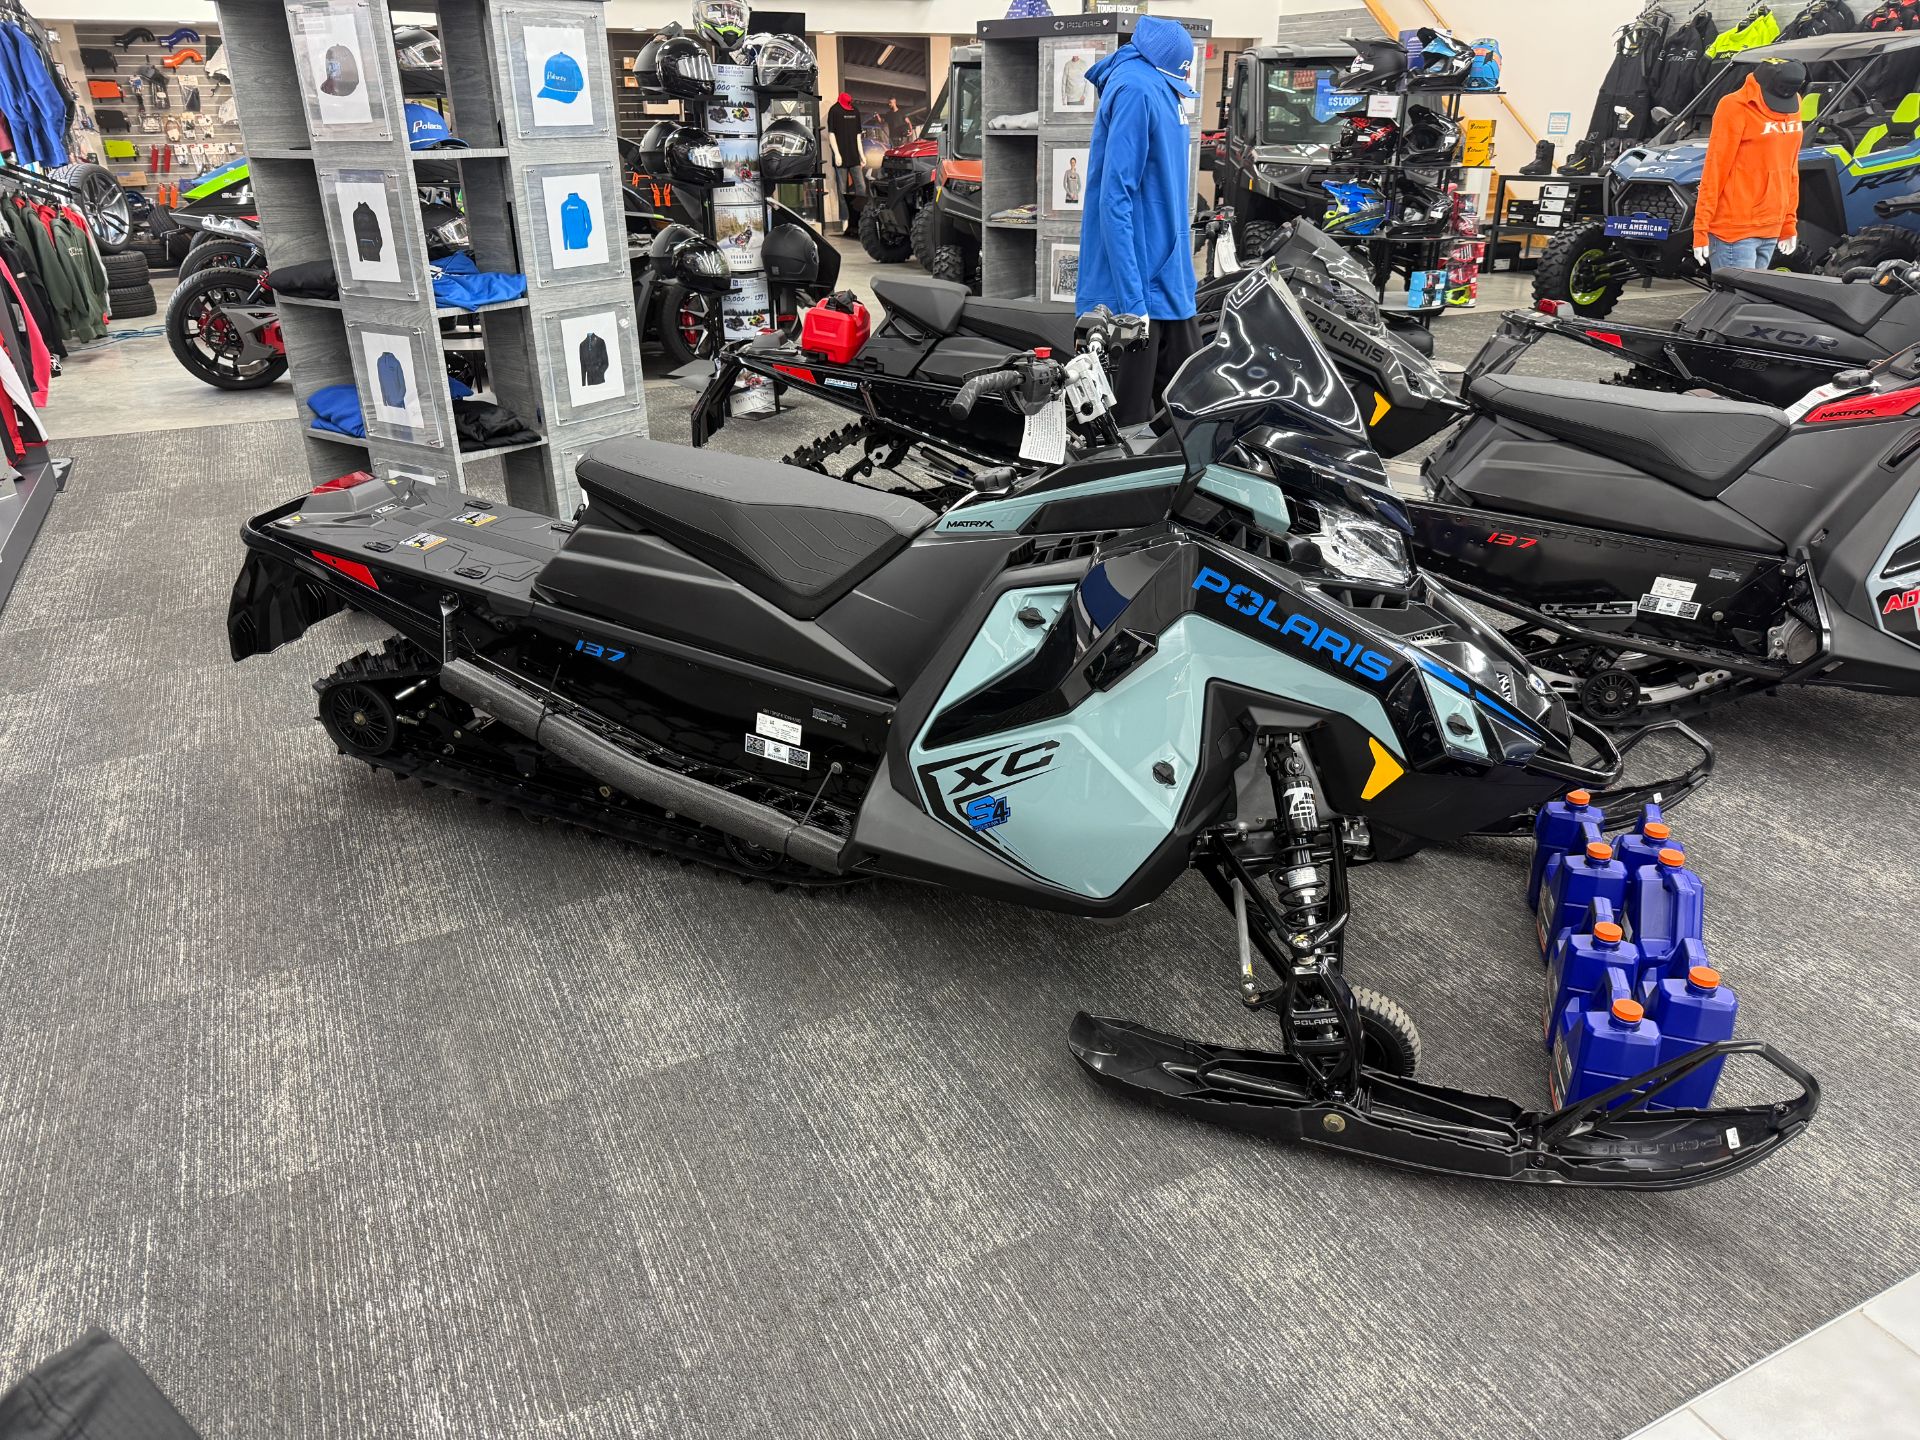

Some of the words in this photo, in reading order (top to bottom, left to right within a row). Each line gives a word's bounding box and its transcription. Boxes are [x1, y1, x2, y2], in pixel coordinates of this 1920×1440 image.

[1066, 20, 1101, 29] POLARIS
[413, 120, 442, 133] Polaris
[1613, 222, 1628, 230] THE
[1628, 224, 1662, 232] AMERICAN
[1305, 311, 1384, 363] POLARIS
[1745, 324, 1839, 350] XCR
[1820, 409, 1875, 419] MATRYX
[947, 520, 994, 529] MATRYX
[1487, 532, 1538, 548] 137
[1192, 566, 1392, 682] POLARIS
[575, 639, 625, 661] 137
[947, 740, 1060, 795] XC
[966, 795, 1010, 826] S4
[1294, 1017, 1338, 1026] POLARIS
